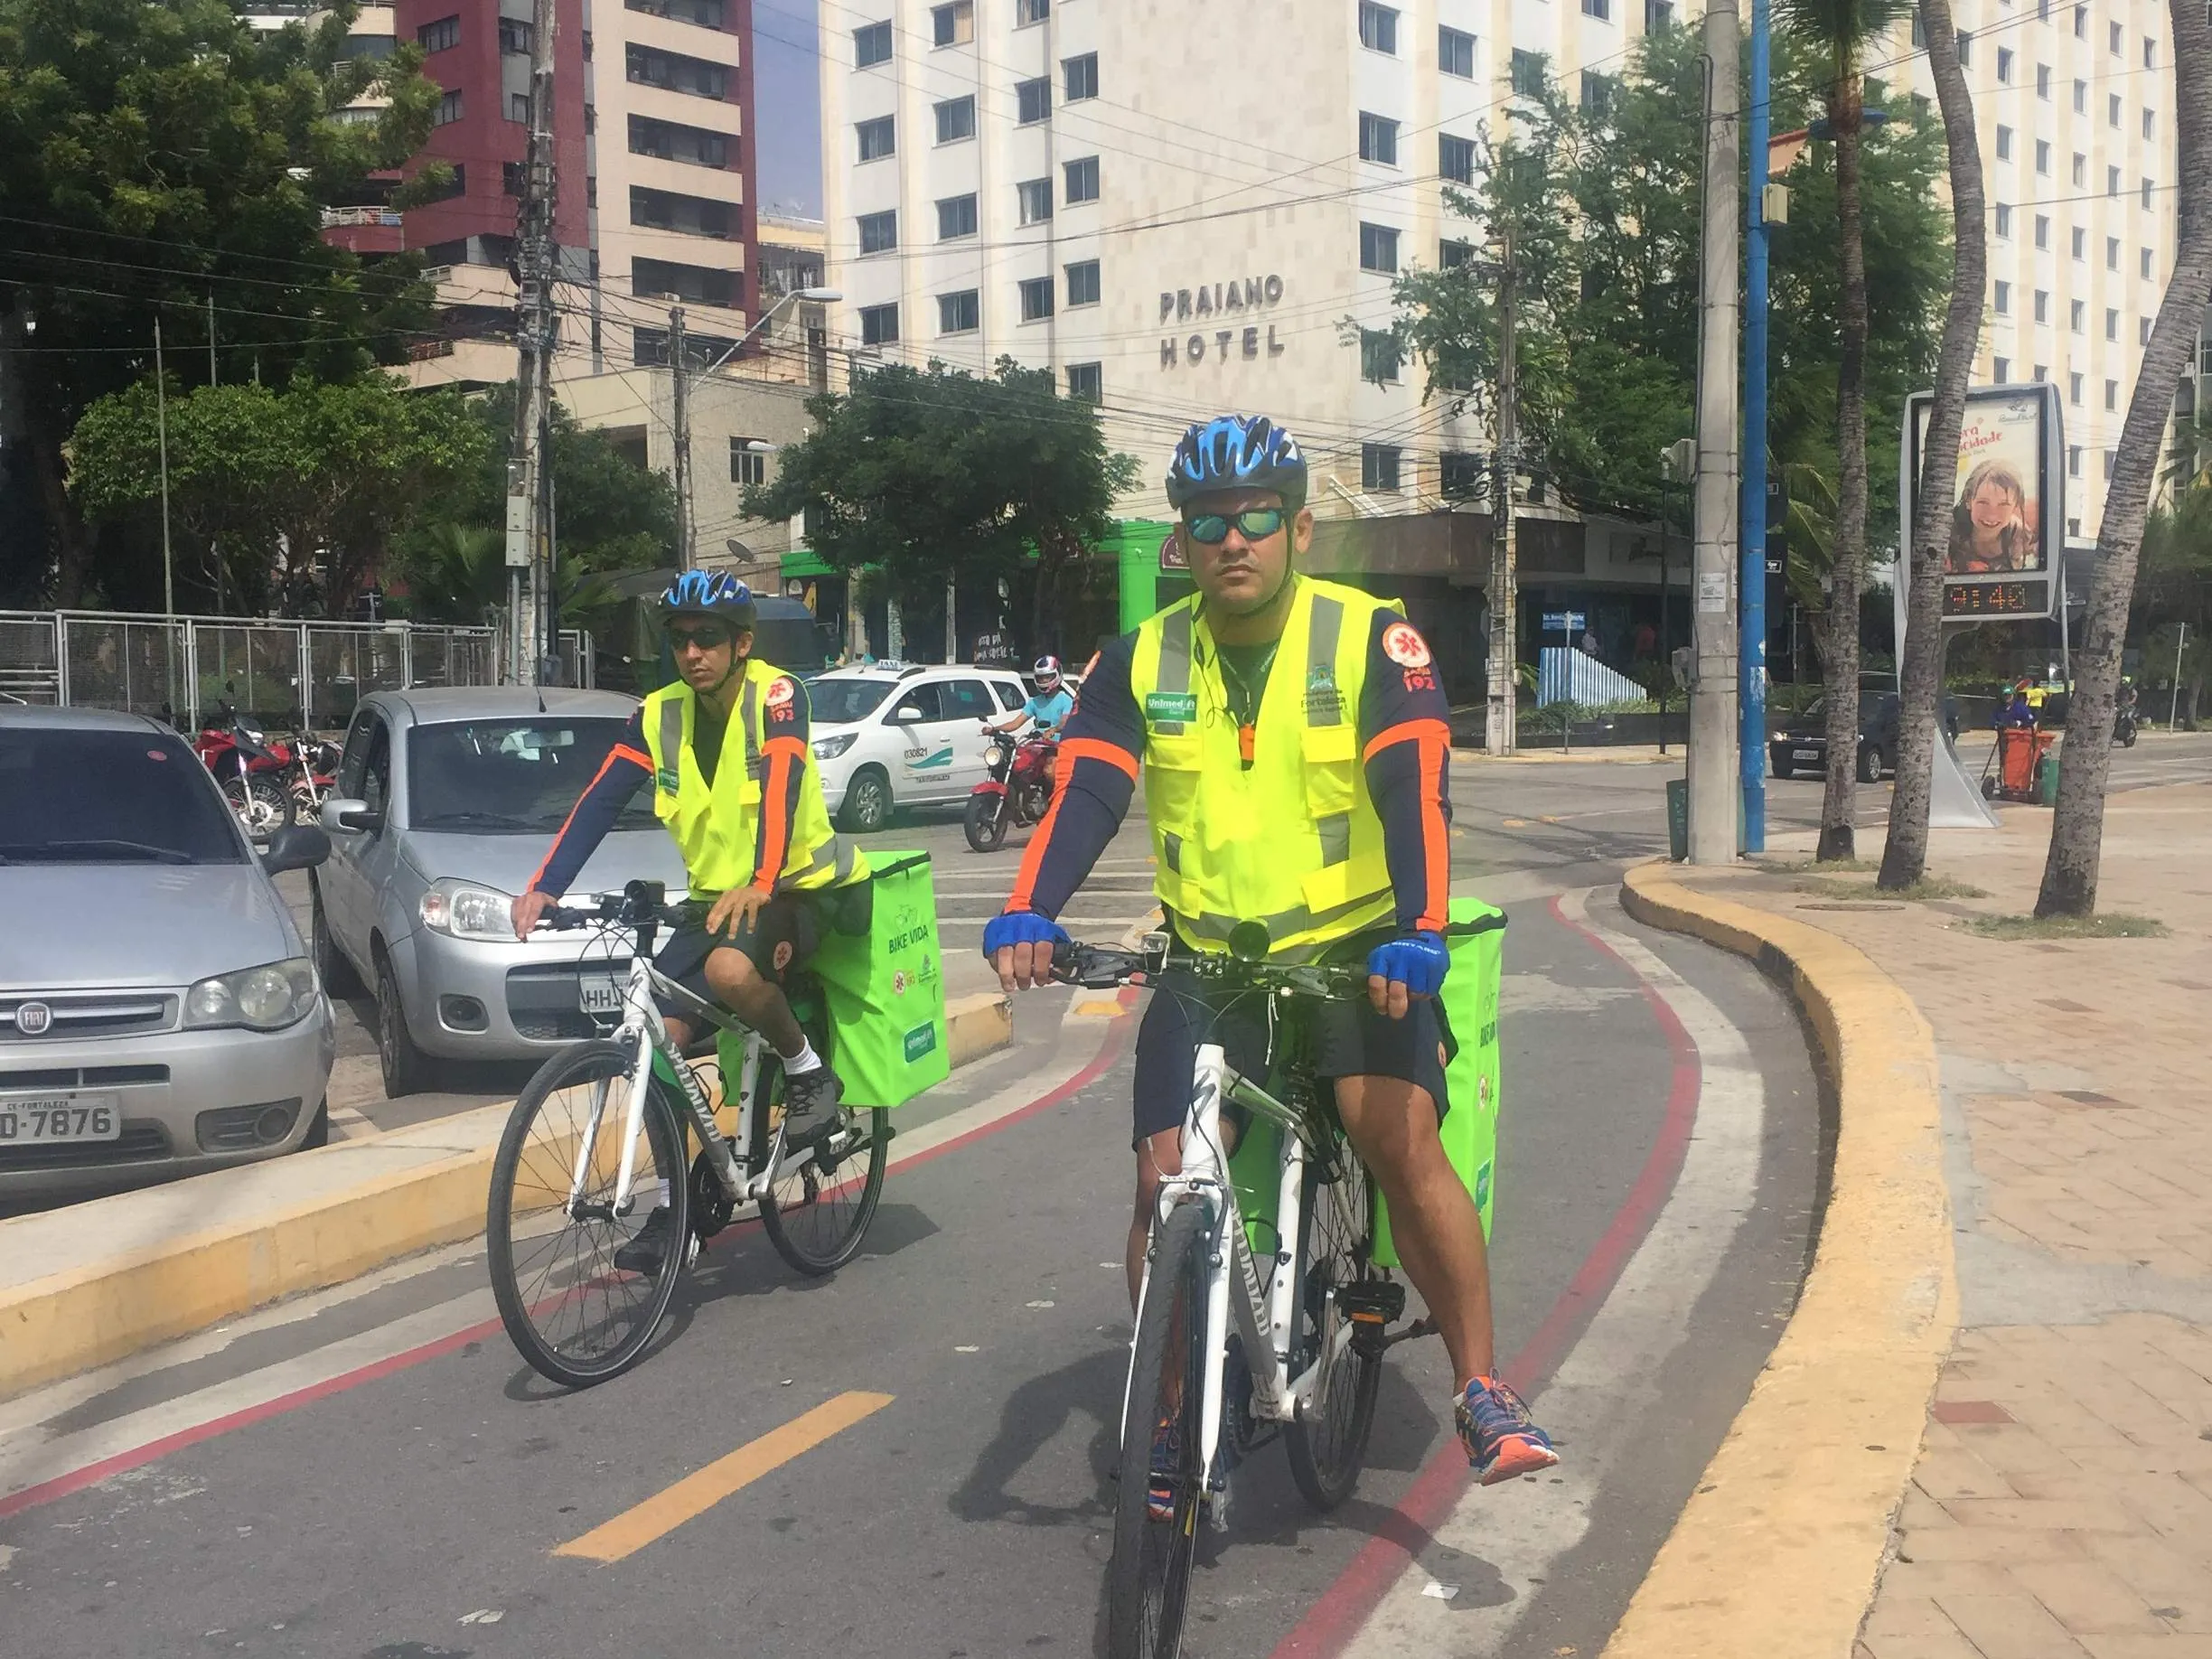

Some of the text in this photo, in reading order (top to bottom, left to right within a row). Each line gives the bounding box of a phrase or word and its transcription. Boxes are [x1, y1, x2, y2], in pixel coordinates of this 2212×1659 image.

[1160, 274, 1284, 323] PRAIANO
[1160, 324, 1285, 369] HOTEL
[1404, 675, 1436, 693] 192
[1148, 698, 1184, 709] Unimed
[888, 924, 929, 954] BIKE VIDA
[23, 1010, 45, 1026] FIAT
[667, 1041, 724, 1143] SPECIALIZED
